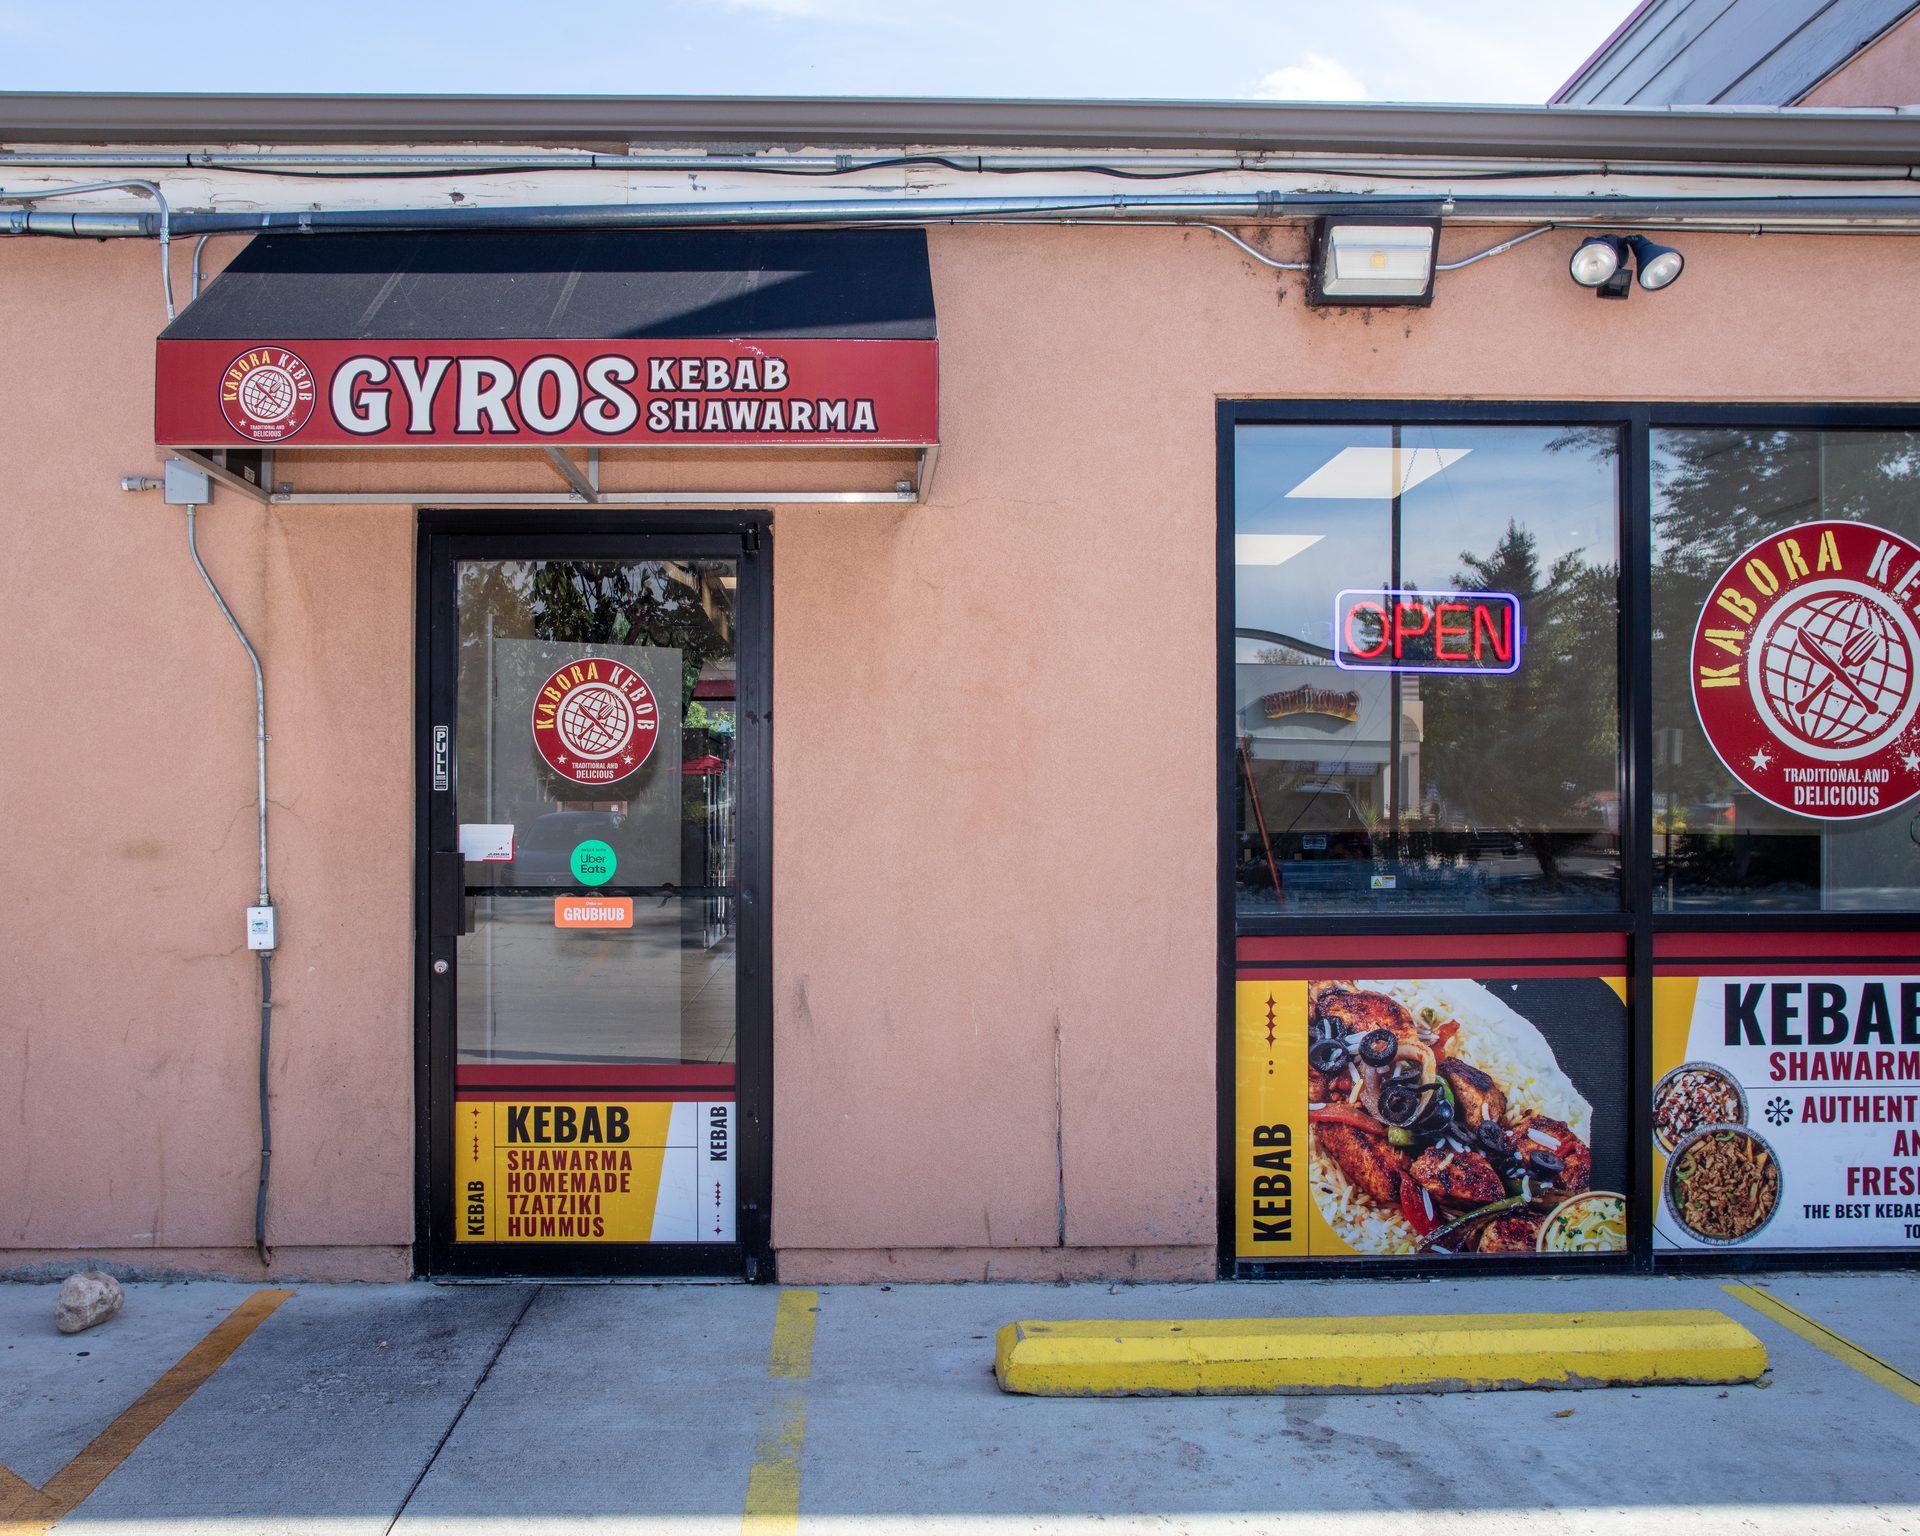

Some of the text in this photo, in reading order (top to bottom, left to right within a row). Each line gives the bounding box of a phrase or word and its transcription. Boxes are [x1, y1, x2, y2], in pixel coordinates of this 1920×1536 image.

[223, 350, 312, 401] KABORA KEBOB
[647, 359, 788, 391] KEBAB
[331, 356, 638, 435] GYROS
[647, 400, 878, 432] SHAWARMA
[1700, 530, 1842, 688] KABORA
[1344, 601, 1512, 662] OPEN
[536, 662, 655, 730] KABORA KEBOB
[436, 731, 446, 775] PULL
[576, 770, 614, 779] DELICIOUS
[1783, 768, 1889, 783] TRADITIONAL AND
[1794, 786, 1880, 806] DELICIOUS
[580, 854, 606, 864] Uber
[580, 864, 607, 874] Eats
[563, 907, 625, 921] GRUBHUB
[507, 1105, 630, 1143] KEBAB
[710, 1105, 727, 1161] KEBAB
[507, 1150, 633, 1171] SHAWARMA
[507, 1172, 631, 1193] HOMEMADE
[1253, 1122, 1292, 1242] KEBAB
[1847, 1166, 1920, 1196] FRES
[467, 1180, 485, 1236] KEBAB
[506, 1194, 600, 1215] TZATZIKI
[1803, 1204, 1830, 1219] THE
[1835, 1204, 1871, 1219] BEST
[508, 1216, 605, 1237] HUMMUS
